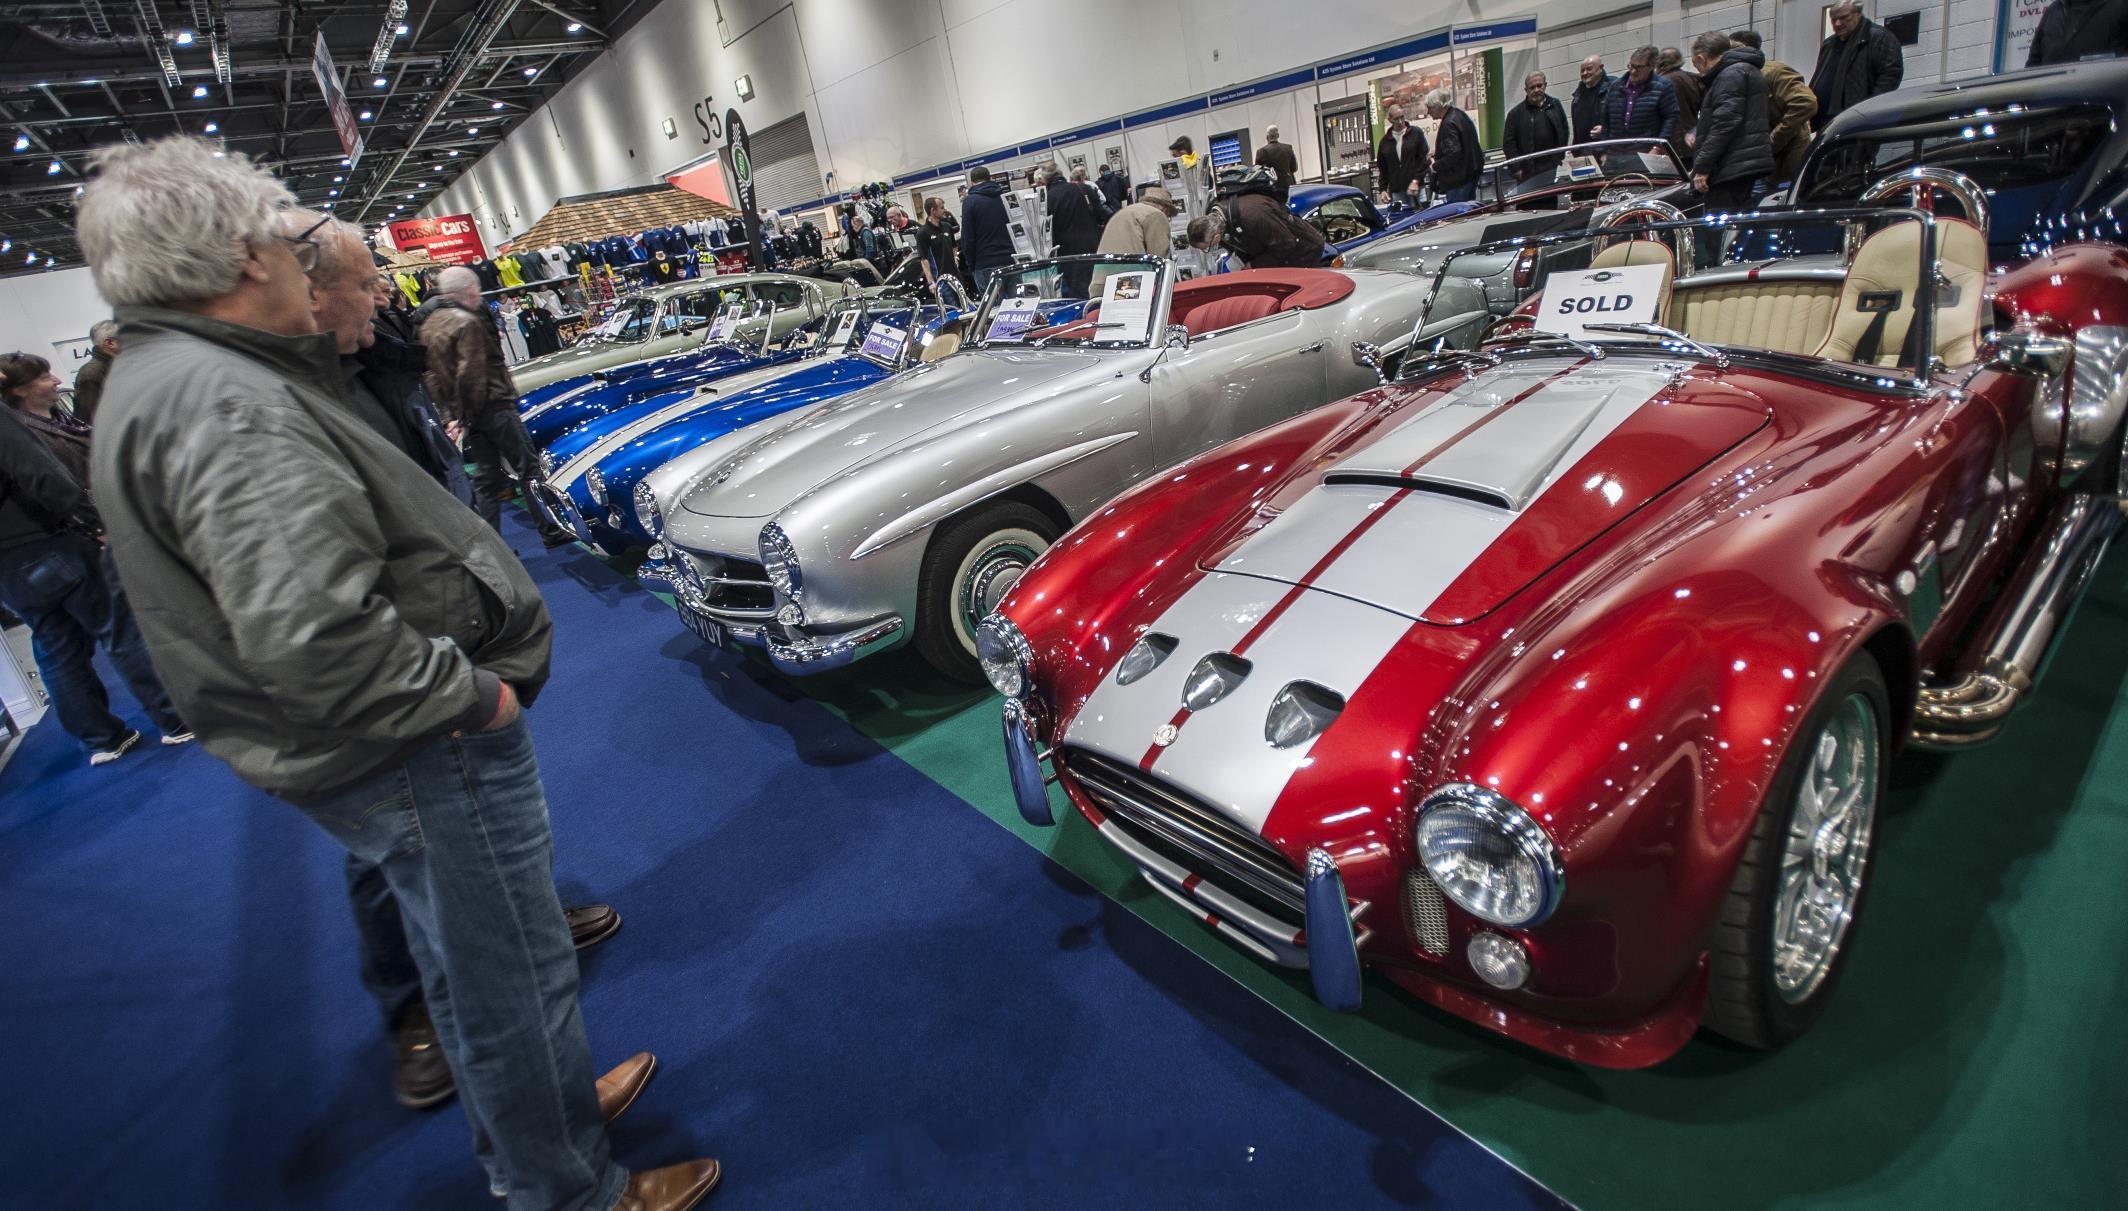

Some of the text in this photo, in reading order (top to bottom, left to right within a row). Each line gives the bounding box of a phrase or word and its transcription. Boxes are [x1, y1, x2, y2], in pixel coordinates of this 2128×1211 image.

[694, 96, 722, 144] S5
[1558, 294, 1634, 314] SOLD
[996, 313, 1031, 323] FOR SALE
[869, 334, 882, 344] FOR
[880, 338, 899, 350] SALE
[696, 615, 722, 648] YUY
